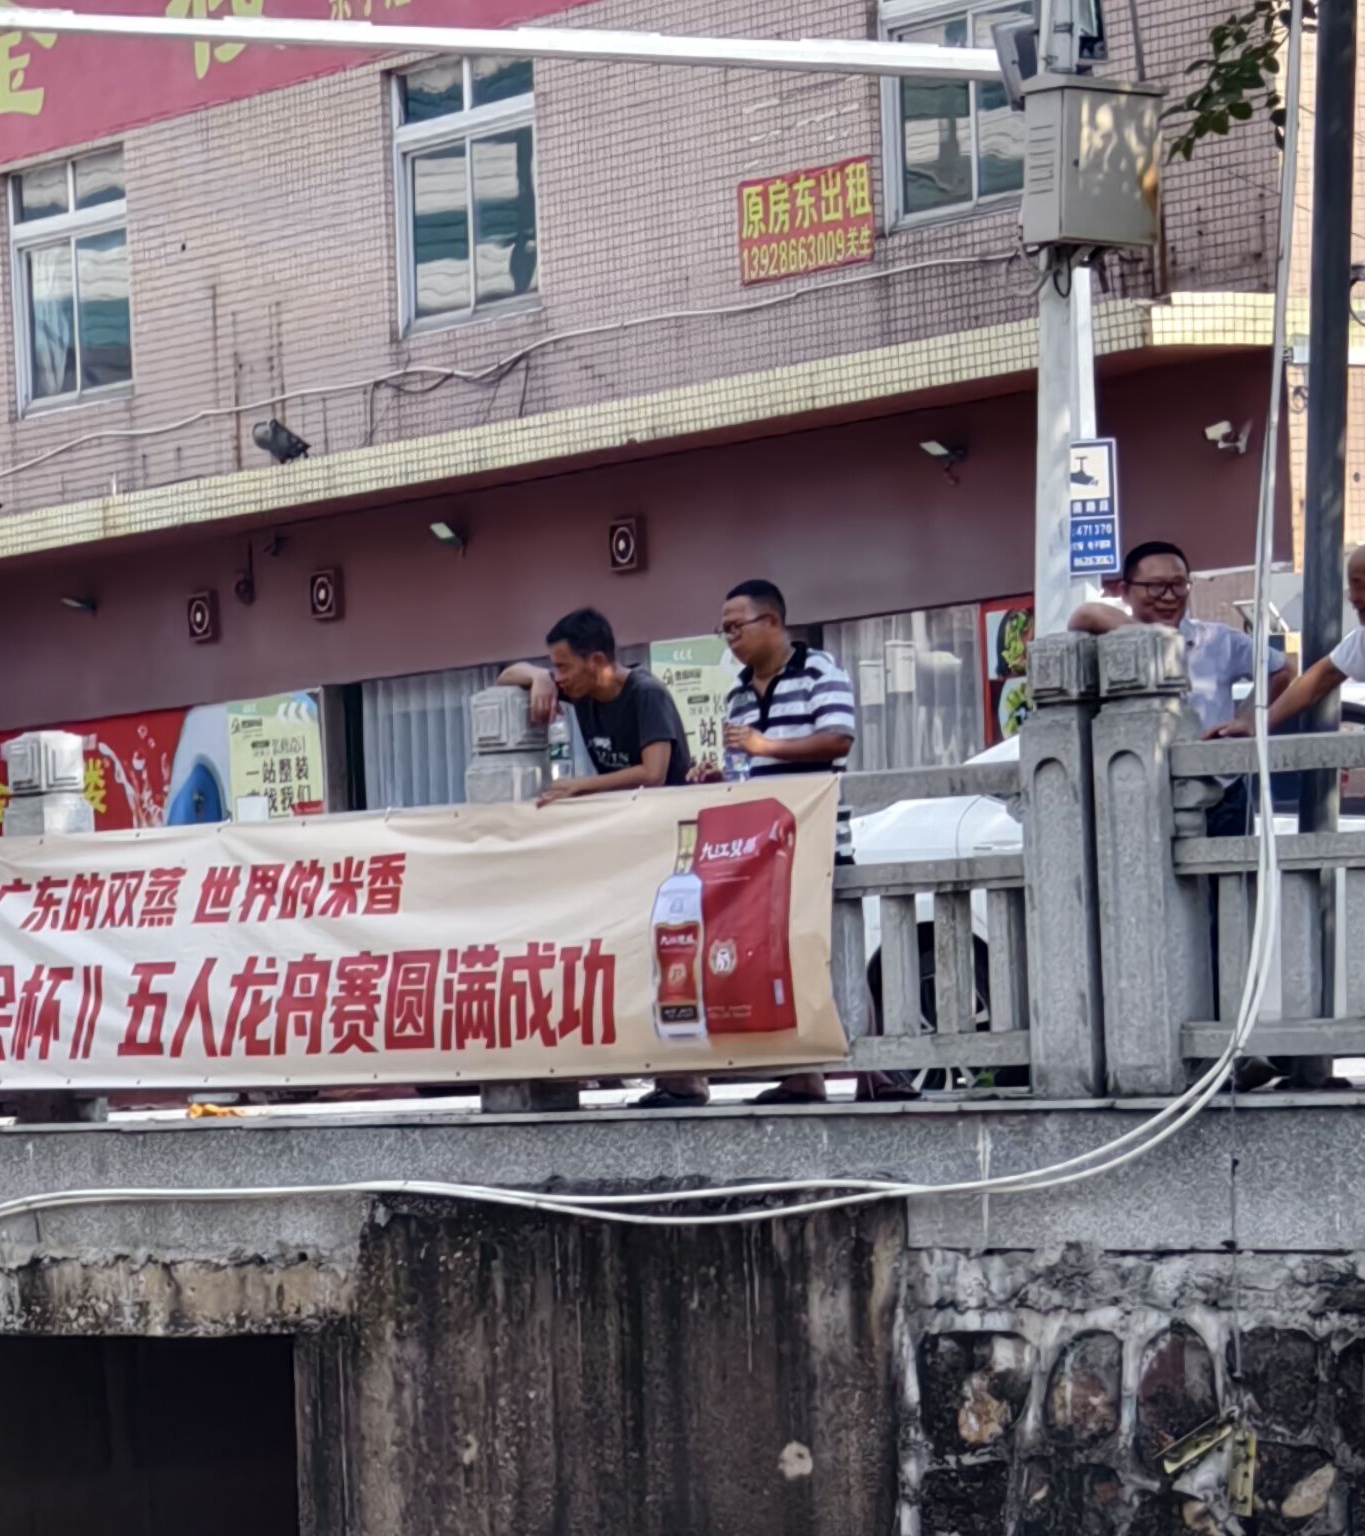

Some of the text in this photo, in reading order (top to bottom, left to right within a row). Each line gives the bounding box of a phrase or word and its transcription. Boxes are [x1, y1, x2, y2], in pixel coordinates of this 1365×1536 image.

[741, 161, 872, 240] 原房东出租
[191, 852, 407, 926] 世界的米香
